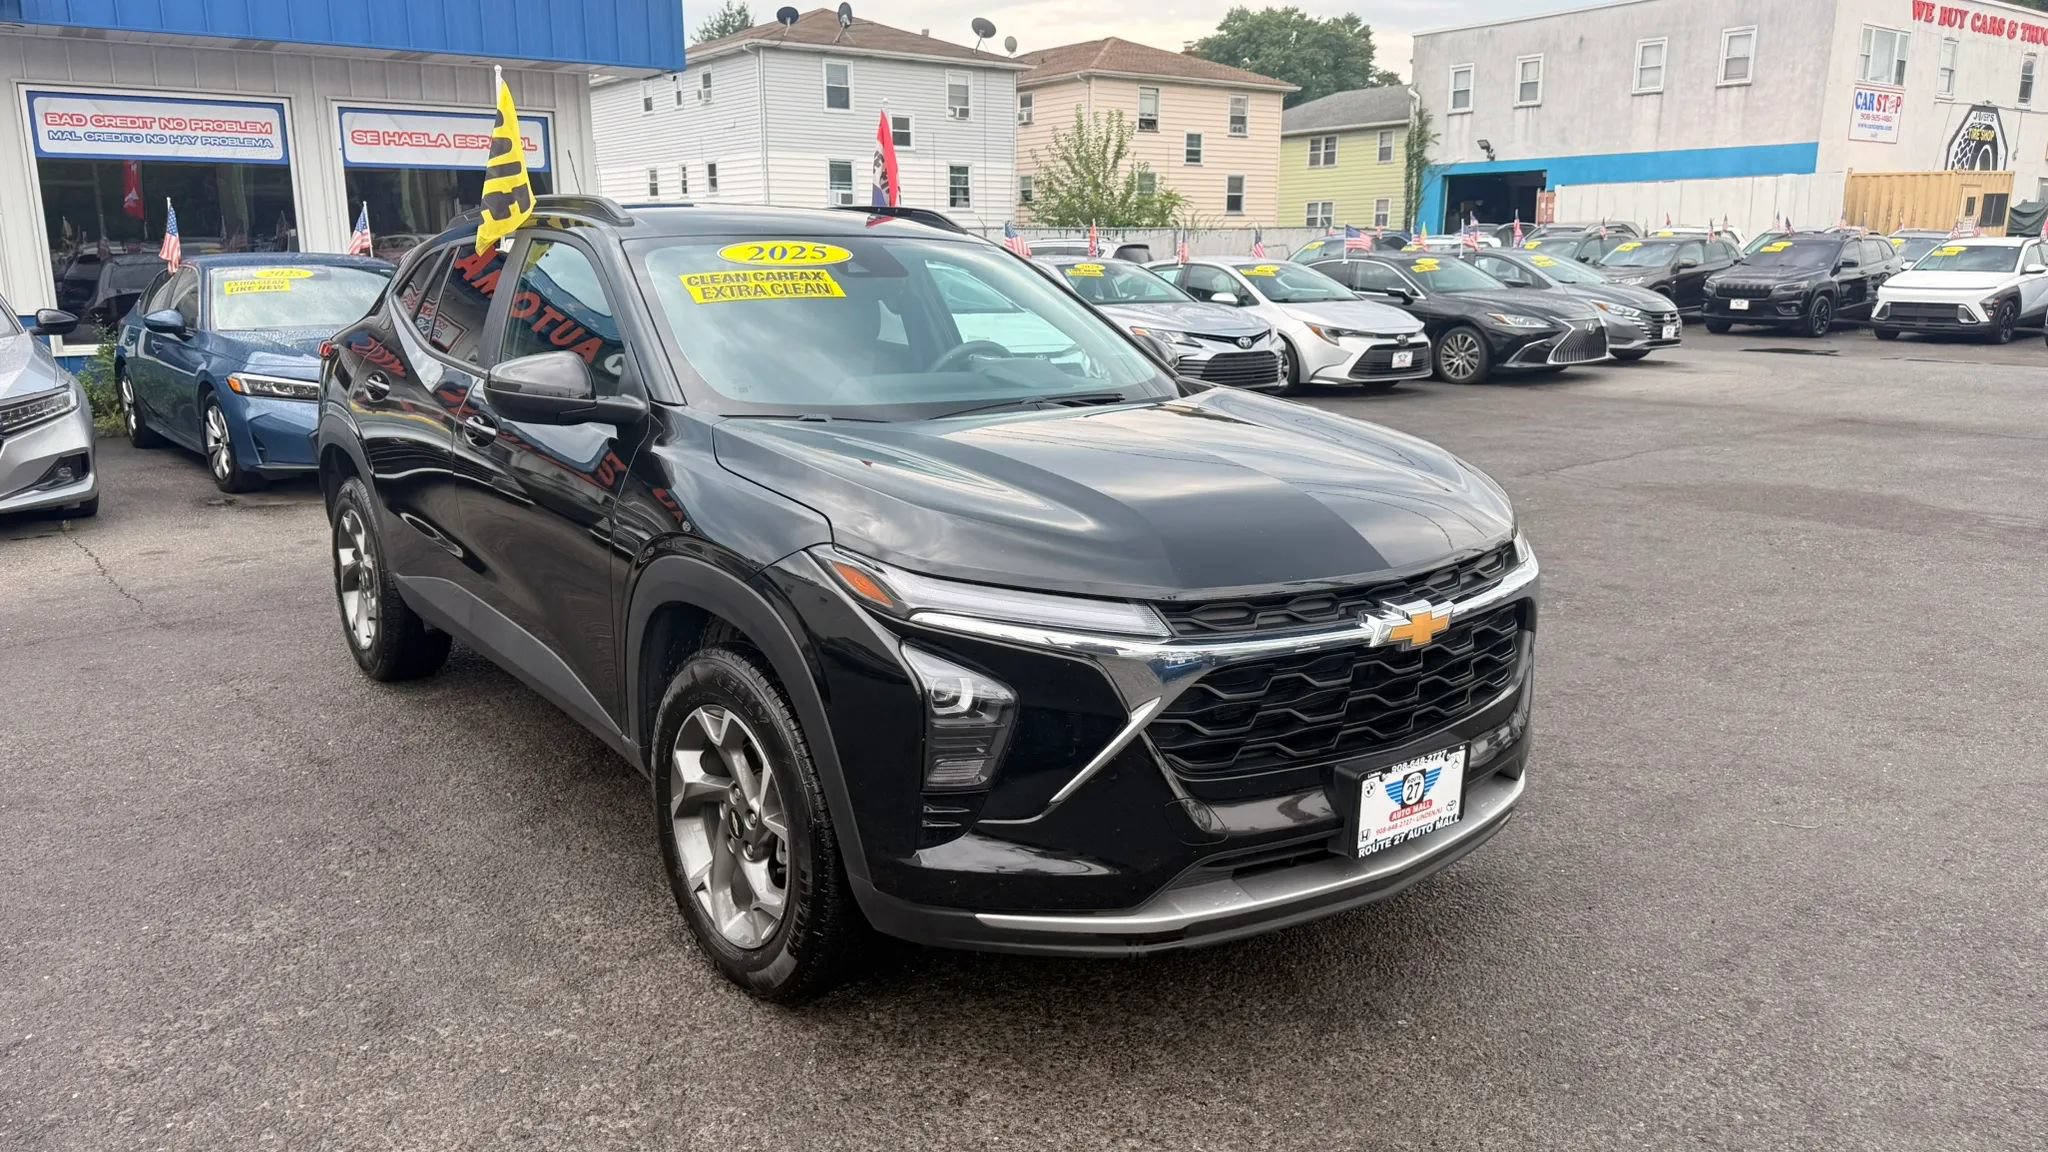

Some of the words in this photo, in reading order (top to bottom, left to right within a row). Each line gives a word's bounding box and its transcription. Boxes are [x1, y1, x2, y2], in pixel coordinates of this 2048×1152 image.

[1912, 0, 1935, 23] WE
[1938, 6, 1969, 29] BUY
[1971, 12, 2006, 37] CARS
[2007, 20, 2019, 40] &
[1855, 91, 1875, 112] CAR
[44, 112, 87, 127] BAD
[90, 114, 157, 131] CREDIT
[159, 116, 186, 131] NO
[188, 119, 273, 135] PROBLEM
[48, 130, 82, 142] MAL
[85, 132, 143, 144] CREDITO
[146, 133, 167, 145] NO
[169, 134, 198, 146] HAY
[201, 136, 274, 148] PROBLEMA
[351, 129, 381, 146] SE
[382, 130, 451, 149] HABLA
[453, 134, 538, 151] ESPL
[748, 245, 827, 261] 2025
[687, 272, 750, 287] CLEAN
[752, 271, 826, 283] CARFAX
[701, 283, 770, 300] EXTRA
[771, 282, 833, 297] CLEAN
[1406, 776, 1422, 784] ROUTE
[1406, 783, 1421, 802] 27
[1392, 809, 1411, 821] AUTO
[1412, 800, 1432, 814] MALL
[1358, 836, 1392, 859] ROUTE
[1393, 832, 1406, 845] 27
[1407, 823, 1435, 841] AUTO
[1435, 813, 1460, 830] MALL
